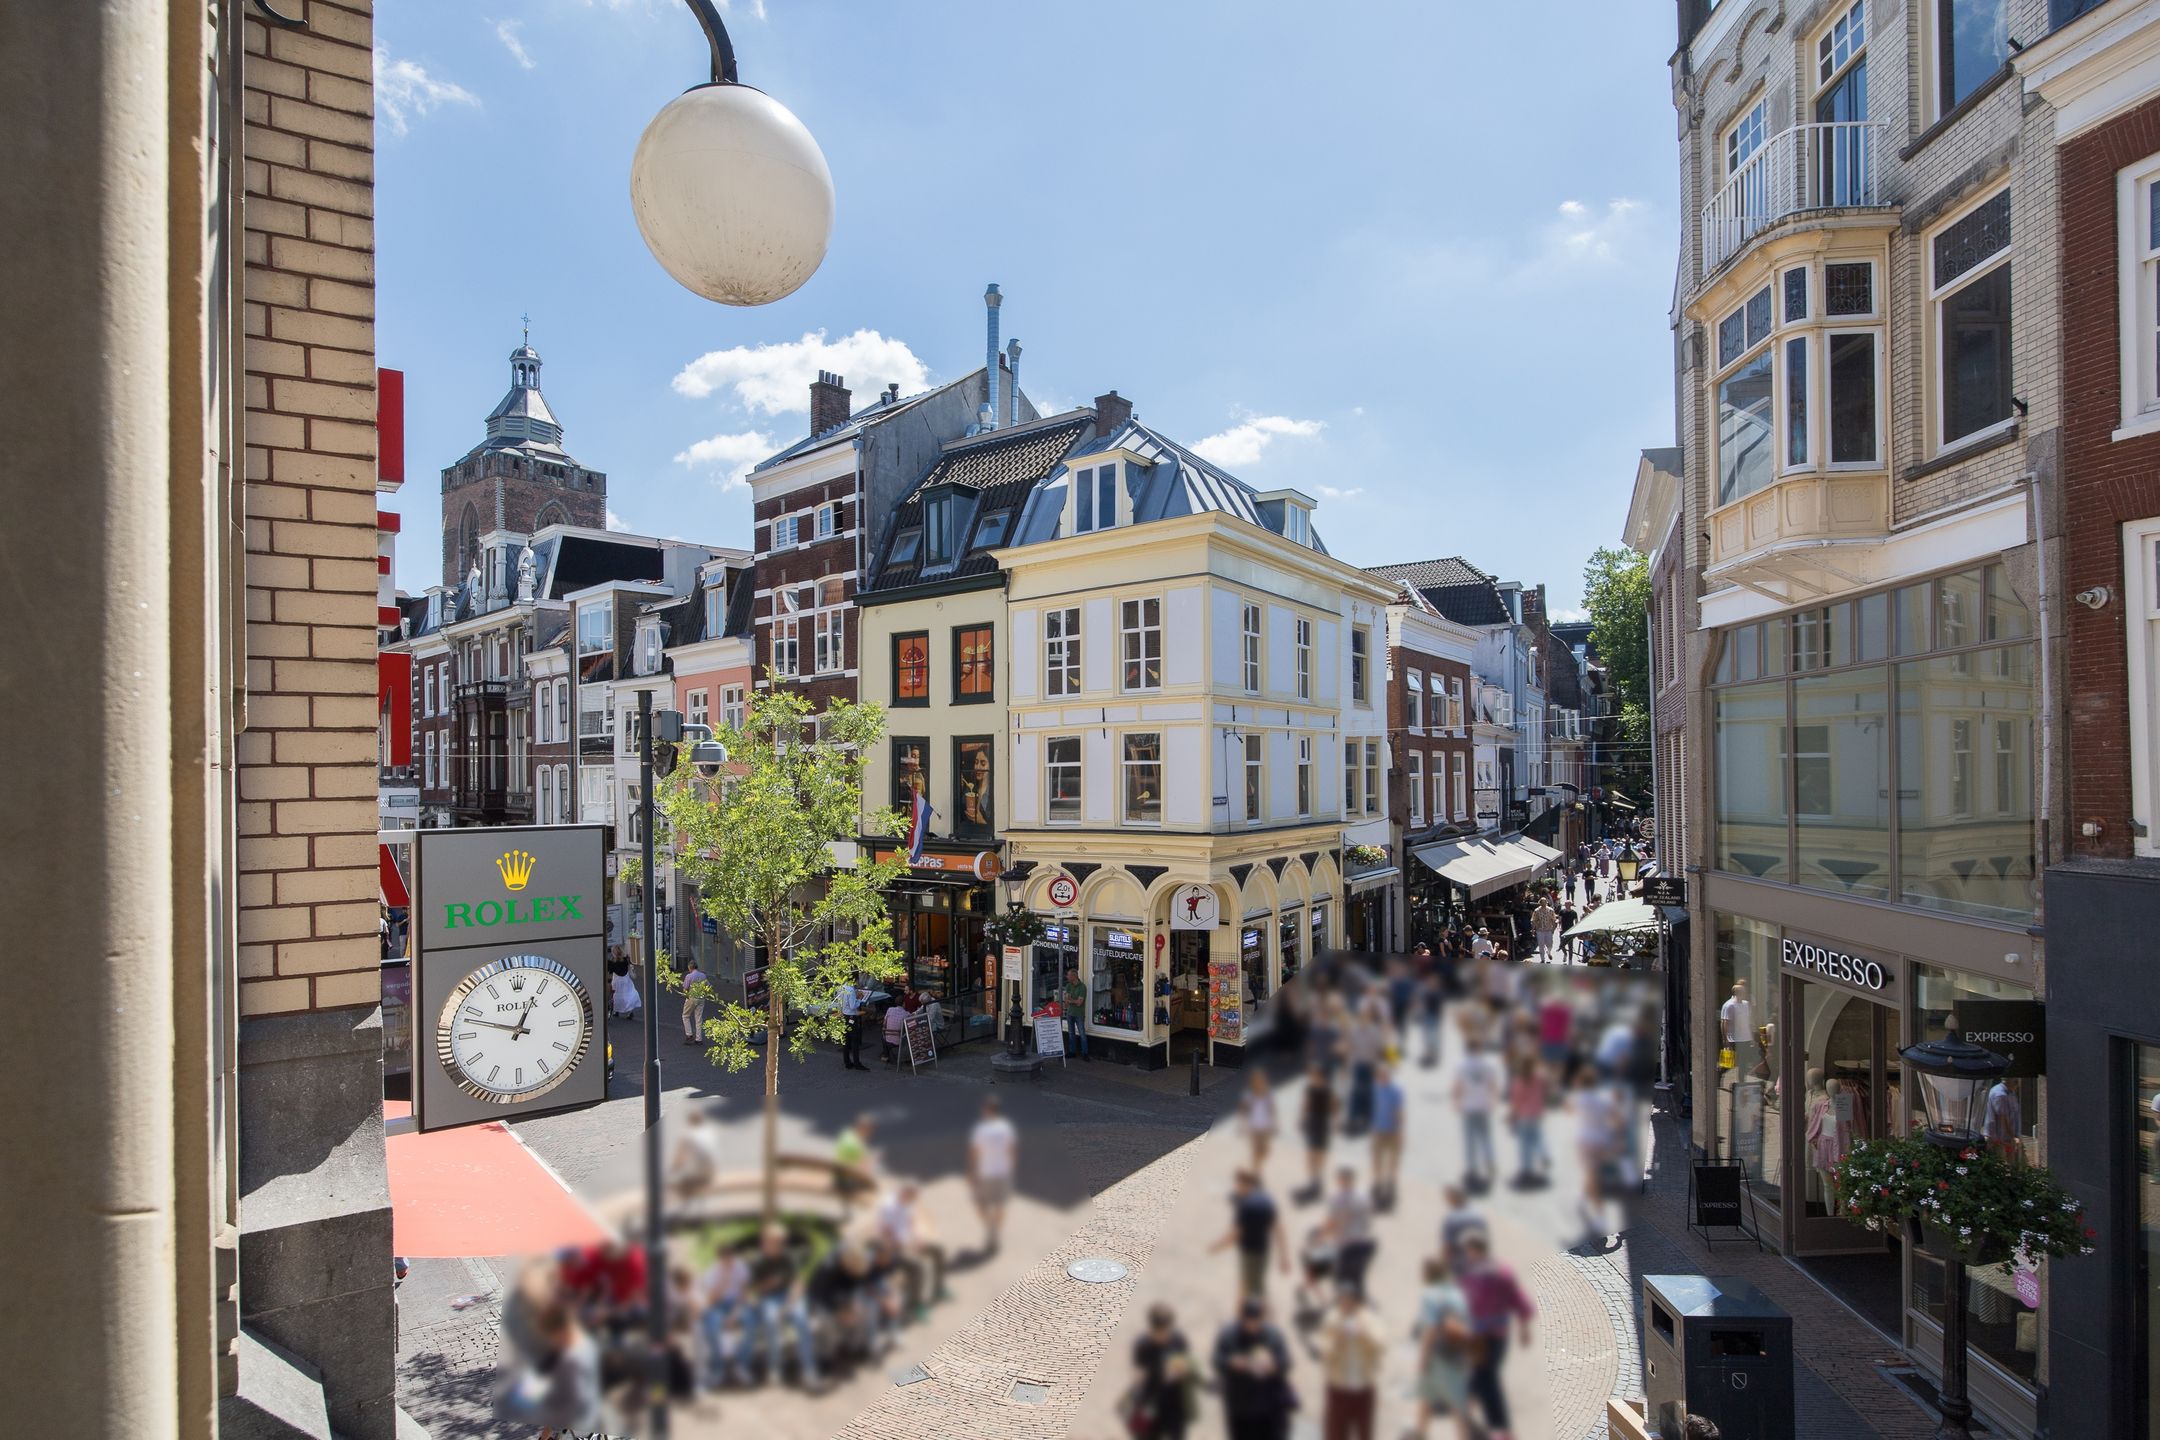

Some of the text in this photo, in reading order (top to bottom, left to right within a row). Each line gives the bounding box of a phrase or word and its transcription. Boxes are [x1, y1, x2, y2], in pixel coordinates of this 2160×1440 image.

[443, 895, 585, 929] ROLEX
[1032, 940, 1078, 953] SCHOENMKERIJ
[1782, 939, 1883, 990] EXPRESSO
[1965, 1031, 2034, 1043] EXPRESSO
